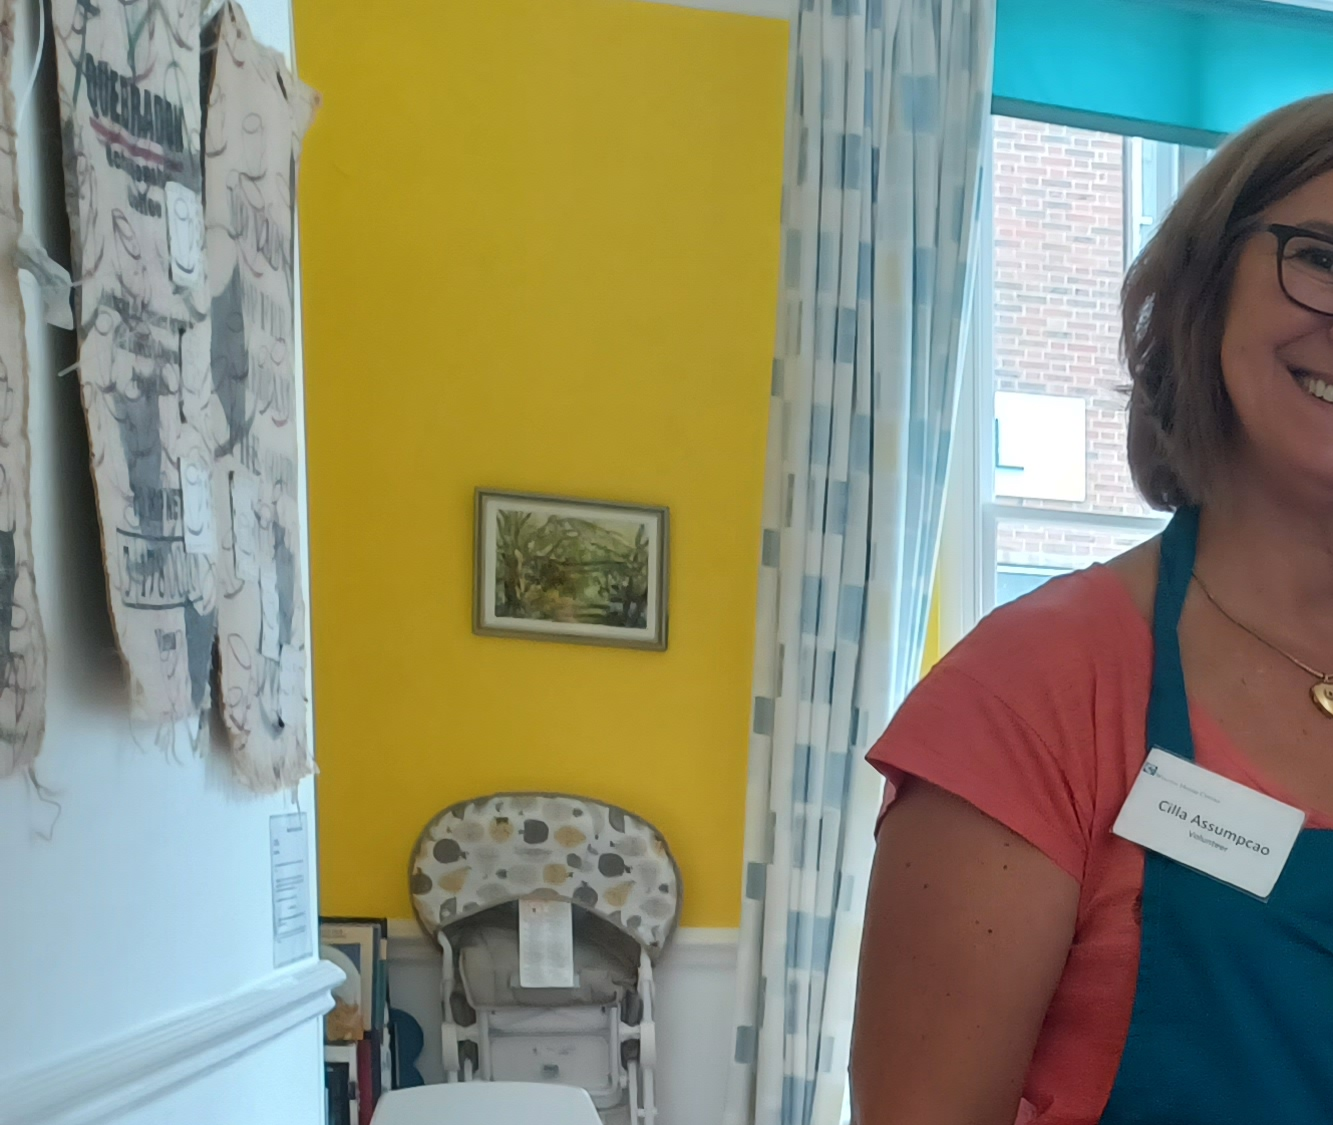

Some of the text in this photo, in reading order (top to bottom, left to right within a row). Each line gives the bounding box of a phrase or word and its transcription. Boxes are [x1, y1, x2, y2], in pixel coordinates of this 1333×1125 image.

[1158, 800, 1271, 856] Cilla Assumpcao
[1188, 830, 1229, 852] Volunteer
